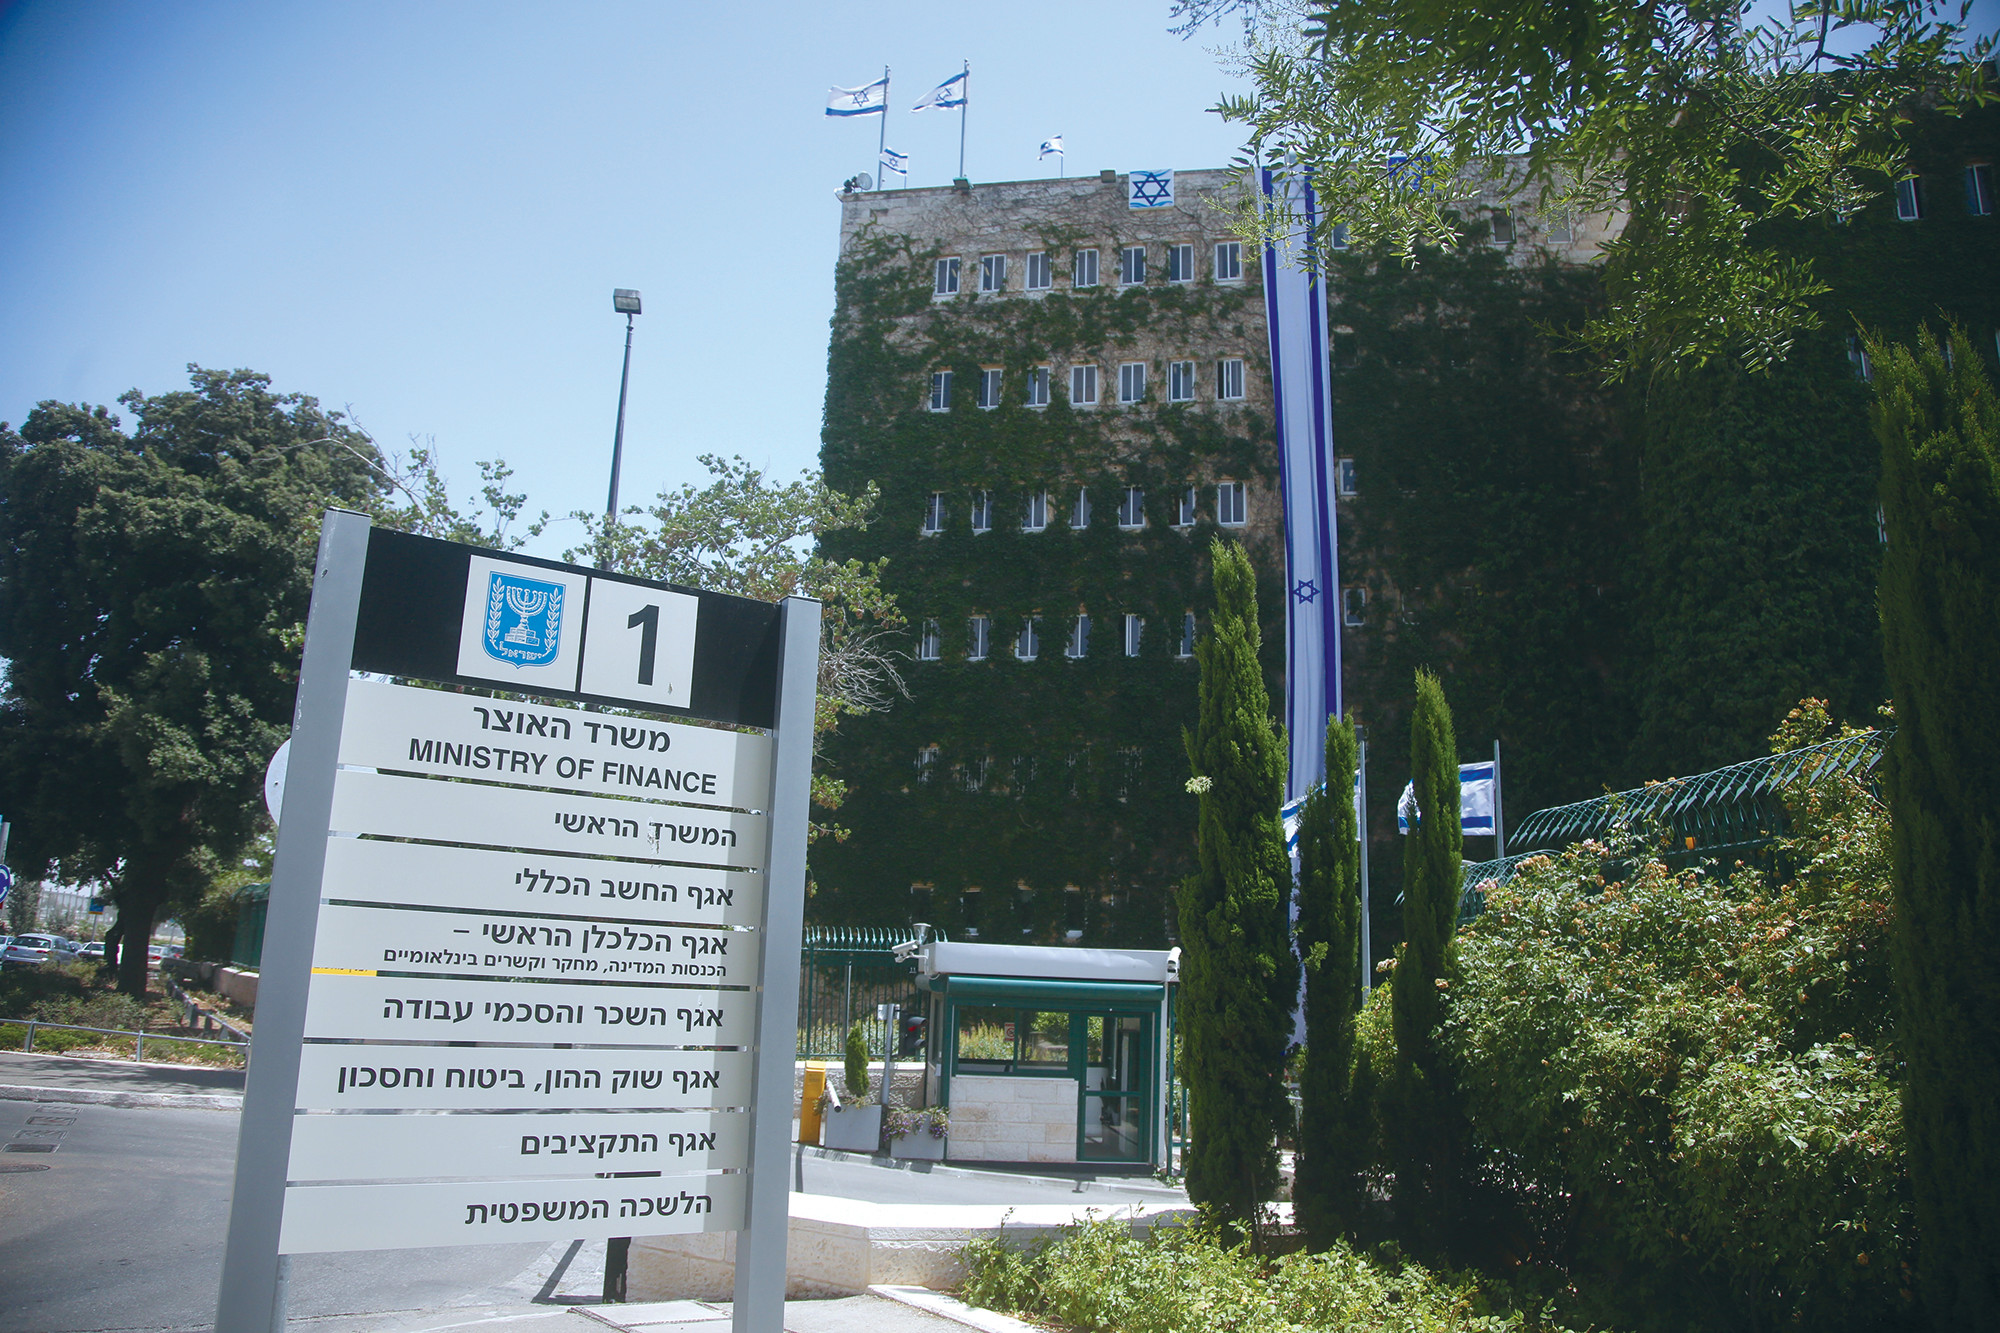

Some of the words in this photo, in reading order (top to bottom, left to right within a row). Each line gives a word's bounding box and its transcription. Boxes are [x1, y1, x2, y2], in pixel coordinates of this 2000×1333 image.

[499, 641, 543, 660] ישראל
[628, 604, 659, 686] 1
[473, 706, 571, 740] האוצר
[583, 721, 671, 753] משרד
[408, 738, 549, 775] MINISTRY
[557, 757, 594, 779] OF
[602, 762, 717, 795] FINANCE
[555, 813, 638, 837] הראשי
[650, 821, 737, 848] המשרד
[516, 868, 590, 896] הכללי
[601, 880, 677, 902] החשב
[688, 887, 733, 909] אגף
[483, 924, 571, 946] הראשי
[583, 926, 674, 953] הכלכלן
[384, 949, 477, 965] בינלאומיים
[682, 936, 728, 959] אגף
[485, 955, 545, 971] וקשרים
[552, 958, 598, 973] מחקר
[603, 961, 665, 974] המדינה,
[672, 964, 726, 976] הכנסות
[384, 999, 473, 1023] עבודה
[485, 1003, 583, 1023] והסכמי
[594, 1006, 666, 1025] השכר
[677, 1009, 723, 1031] אגף
[338, 1067, 434, 1093] וחסכון
[445, 1069, 526, 1089] ביטוח
[534, 1070, 601, 1095] ההון,
[612, 1071, 662, 1093] שוק
[673, 1071, 719, 1093] אגף
[521, 1134, 657, 1158] התקציבים
[669, 1132, 717, 1157] אגף
[465, 1200, 608, 1224] המשפטית
[620, 1191, 711, 1217] הלשכה
